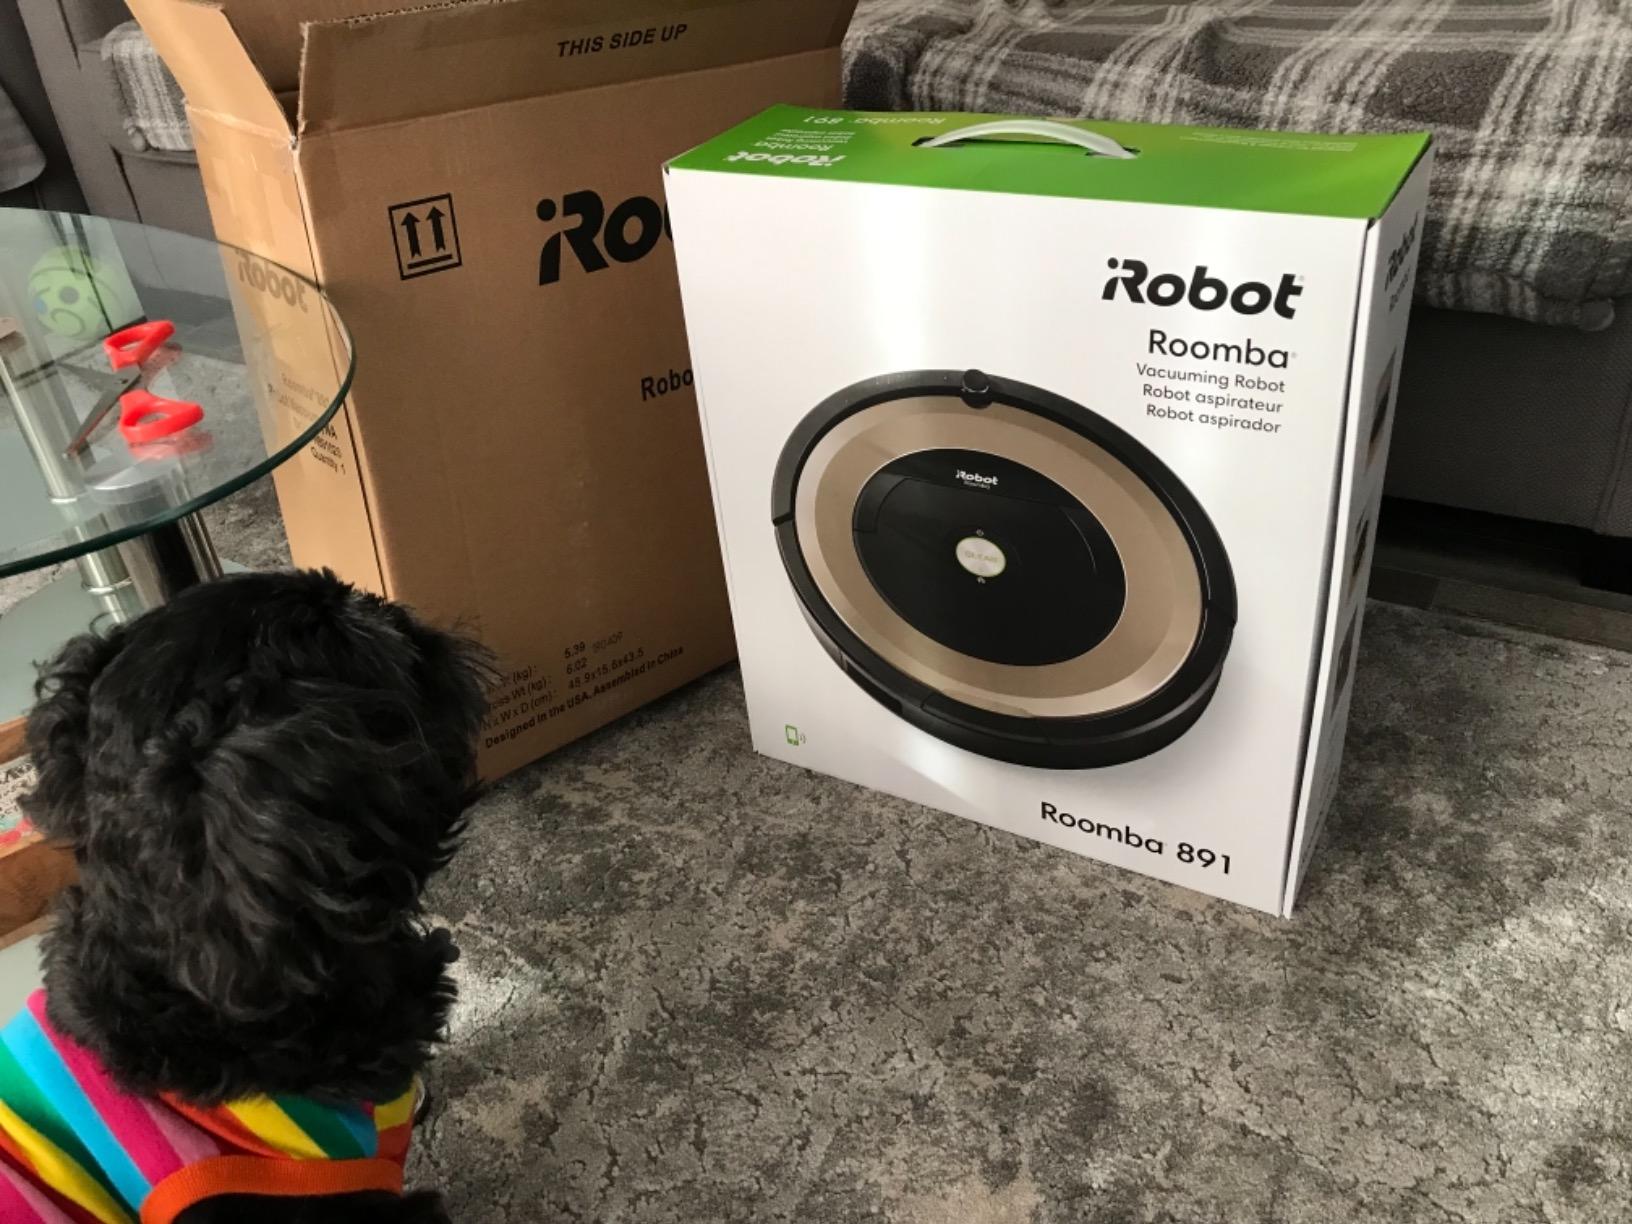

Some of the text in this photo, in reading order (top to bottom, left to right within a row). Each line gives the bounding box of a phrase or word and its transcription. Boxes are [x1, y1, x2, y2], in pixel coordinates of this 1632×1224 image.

[557, 24, 688, 57] THIS SIDE UP
[725, 150, 847, 167] iRobot
[536, 189, 673, 286] iRo
[1101, 257, 1304, 320] iRobot
[1148, 328, 1289, 369] Roomba
[1136, 362, 1286, 393] Vacuuming Robot
[1143, 383, 1284, 414] Robot aspirateur
[1146, 404, 1282, 434] Robot aspirador
[955, 469, 999, 486] iRobot
[485, 716, 536, 749] Designed
[537, 713, 548, 723] in
[549, 703, 566, 718] the
[594, 664, 646, 696] Assembled
[647, 659, 657, 670] in
[657, 646, 684, 665] China
[1040, 801, 1231, 875] Roomba 891
